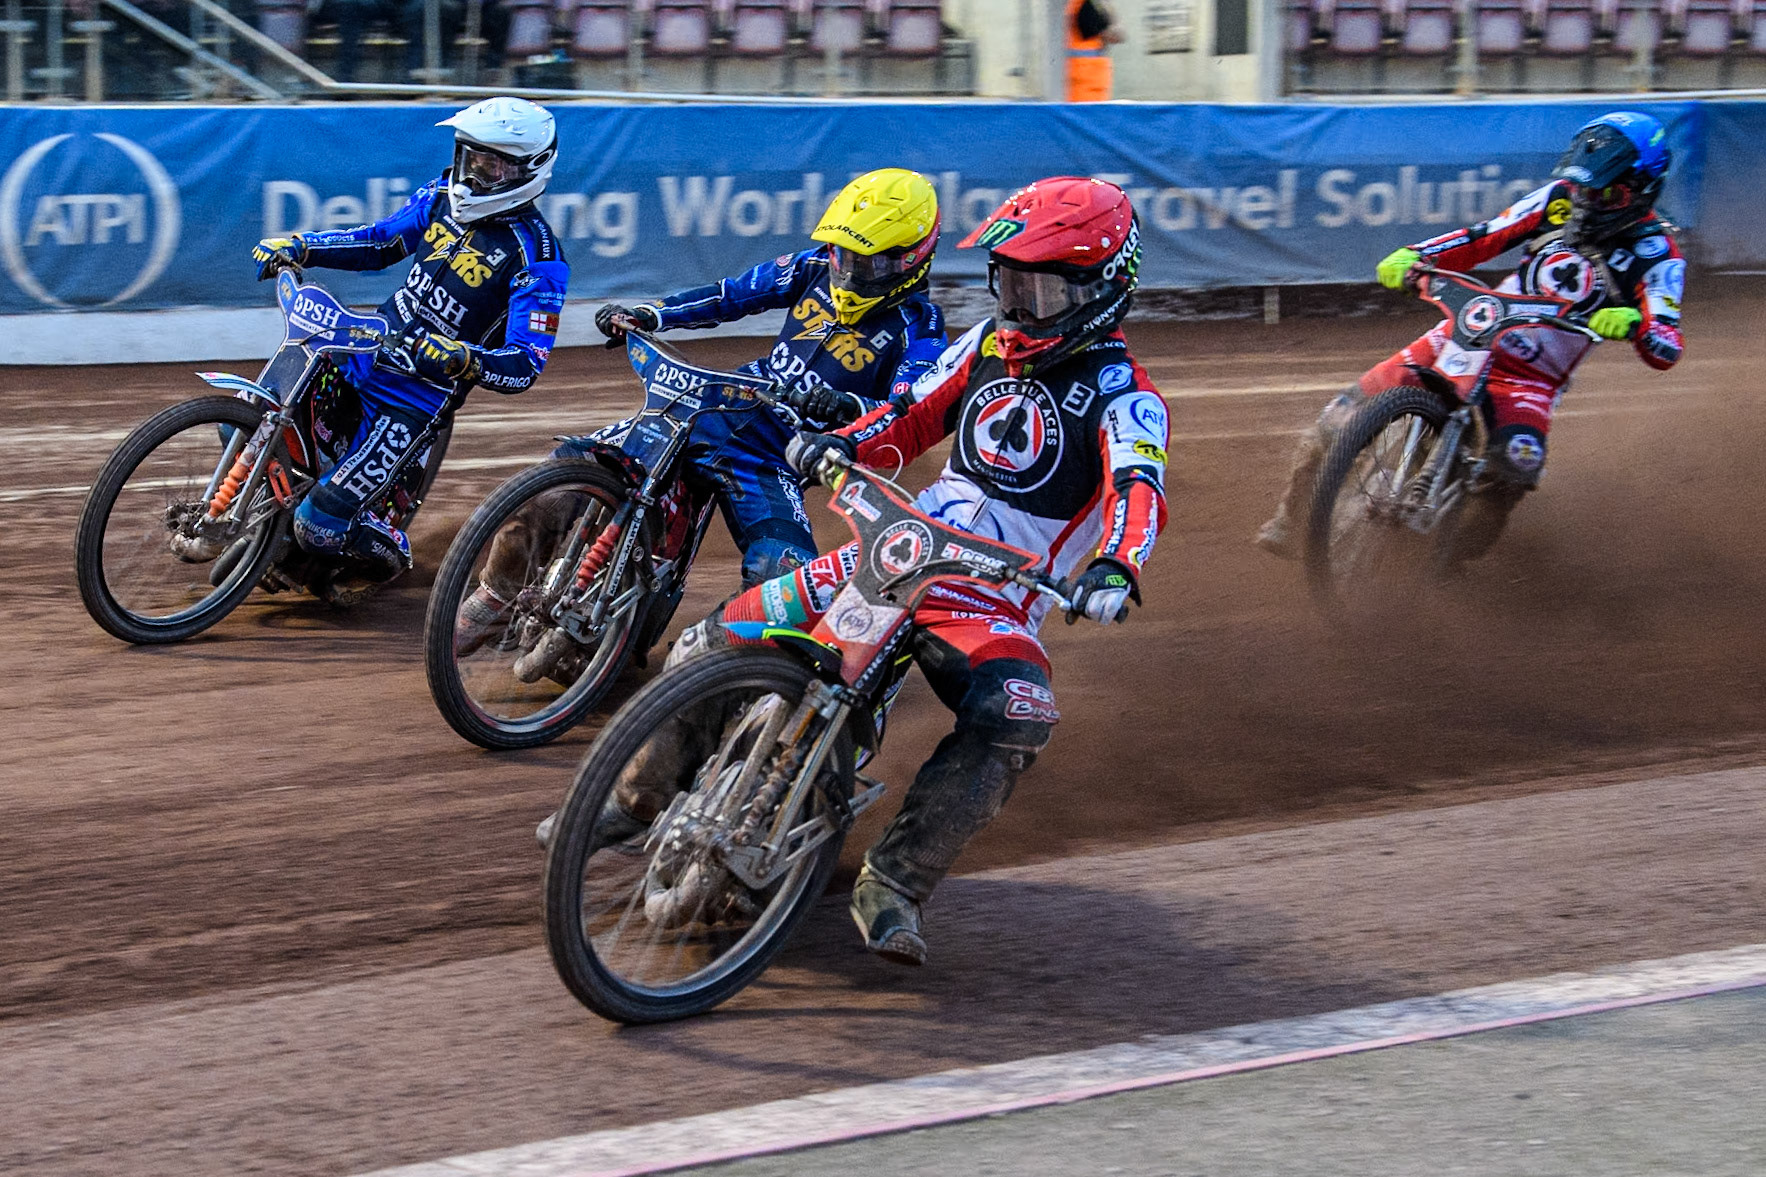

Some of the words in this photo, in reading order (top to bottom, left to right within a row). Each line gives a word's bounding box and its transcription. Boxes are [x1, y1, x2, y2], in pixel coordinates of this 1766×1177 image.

[23, 193, 146, 247] ATPI
[262, 177, 638, 258] Deling
[655, 171, 868, 238] Worl
[1314, 164, 1551, 228] Soluti
[423, 222, 493, 288] STARS
[1102, 219, 1140, 281] OAKLEY
[792, 298, 875, 373] STARS
[481, 370, 531, 388] 3PLFRIGO
[976, 383, 1017, 407] BELLE
[1041, 407, 1058, 447] ACES
[809, 556, 837, 591] EK
